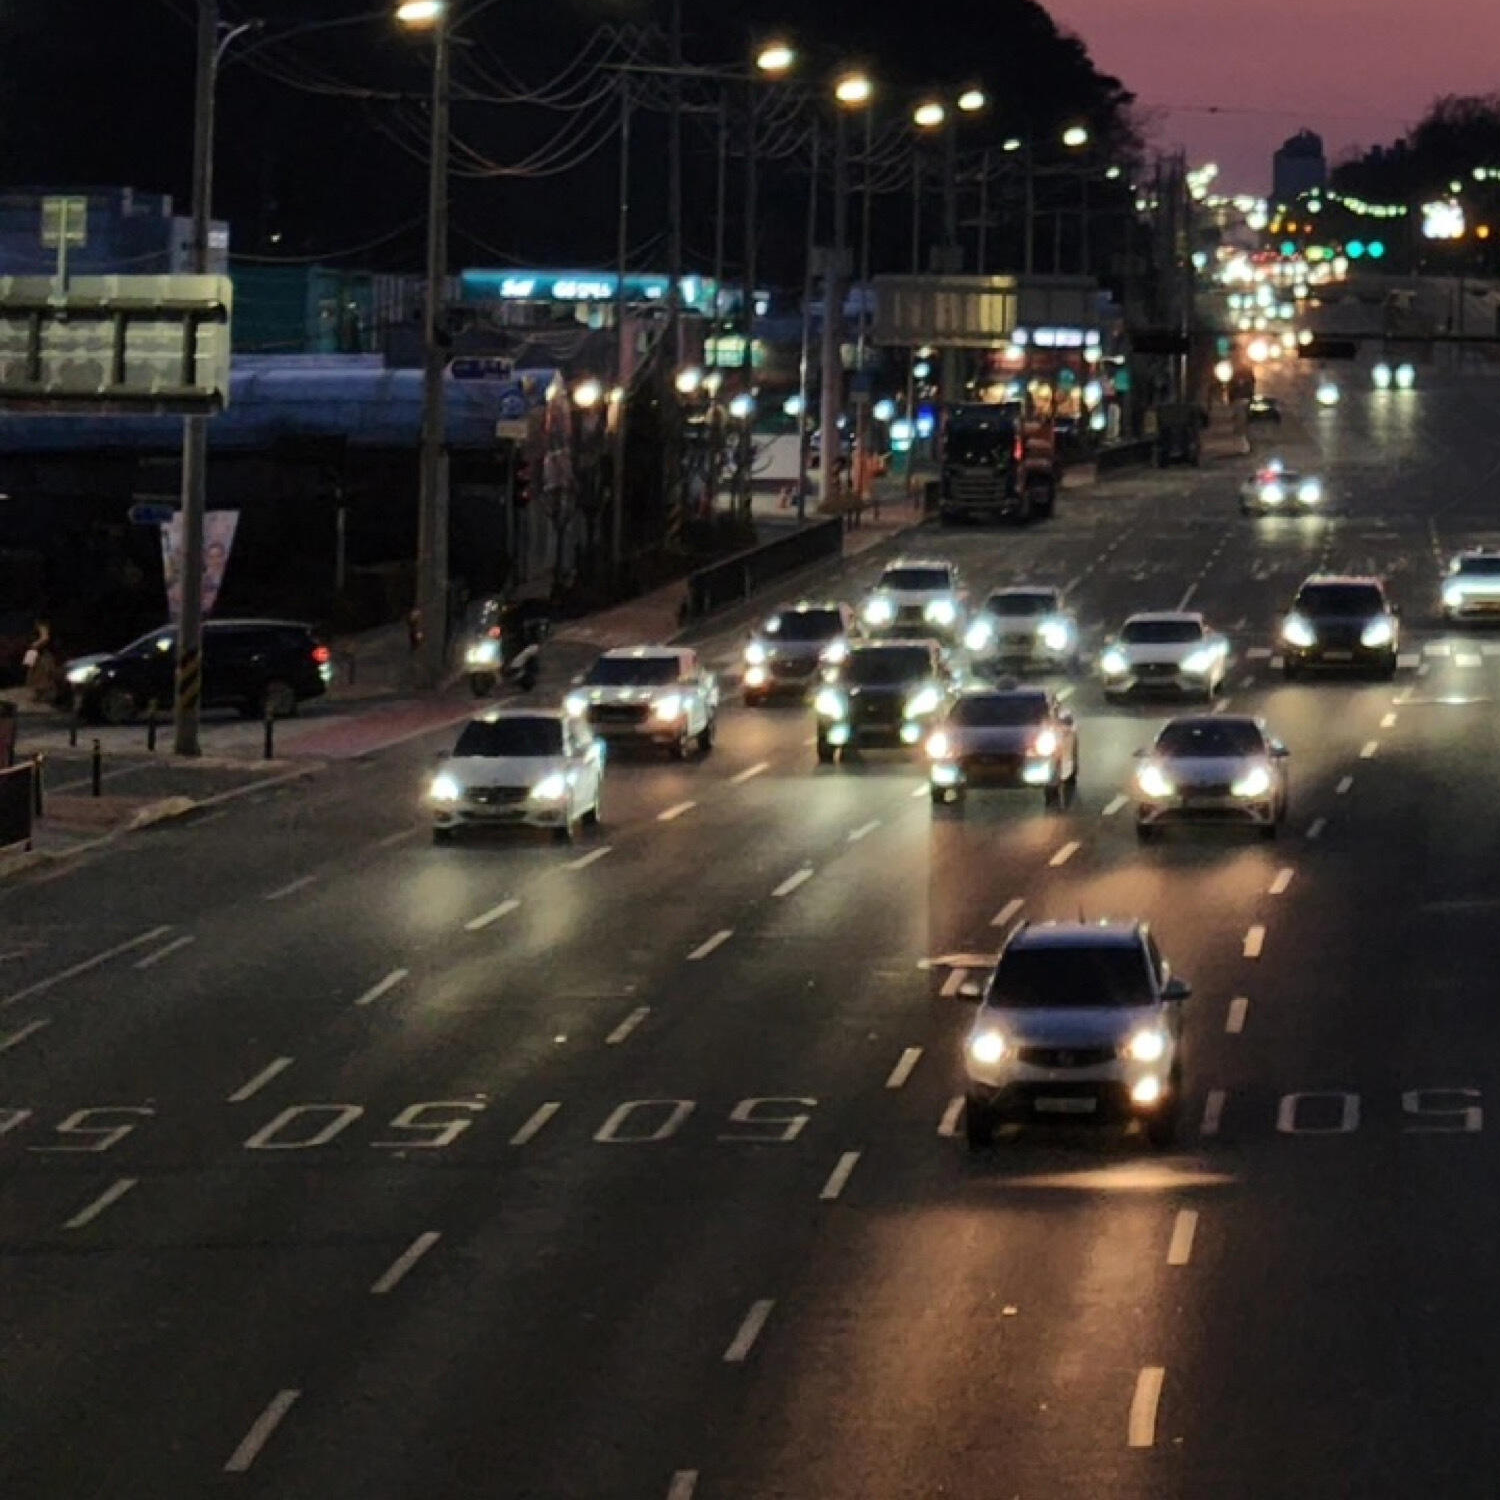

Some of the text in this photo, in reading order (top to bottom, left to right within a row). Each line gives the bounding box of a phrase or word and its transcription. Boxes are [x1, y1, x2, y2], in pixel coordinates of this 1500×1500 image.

[243, 1101, 487, 1150] 50
[592, 1097, 817, 1145] 50
[1276, 1088, 1483, 1134] 50
